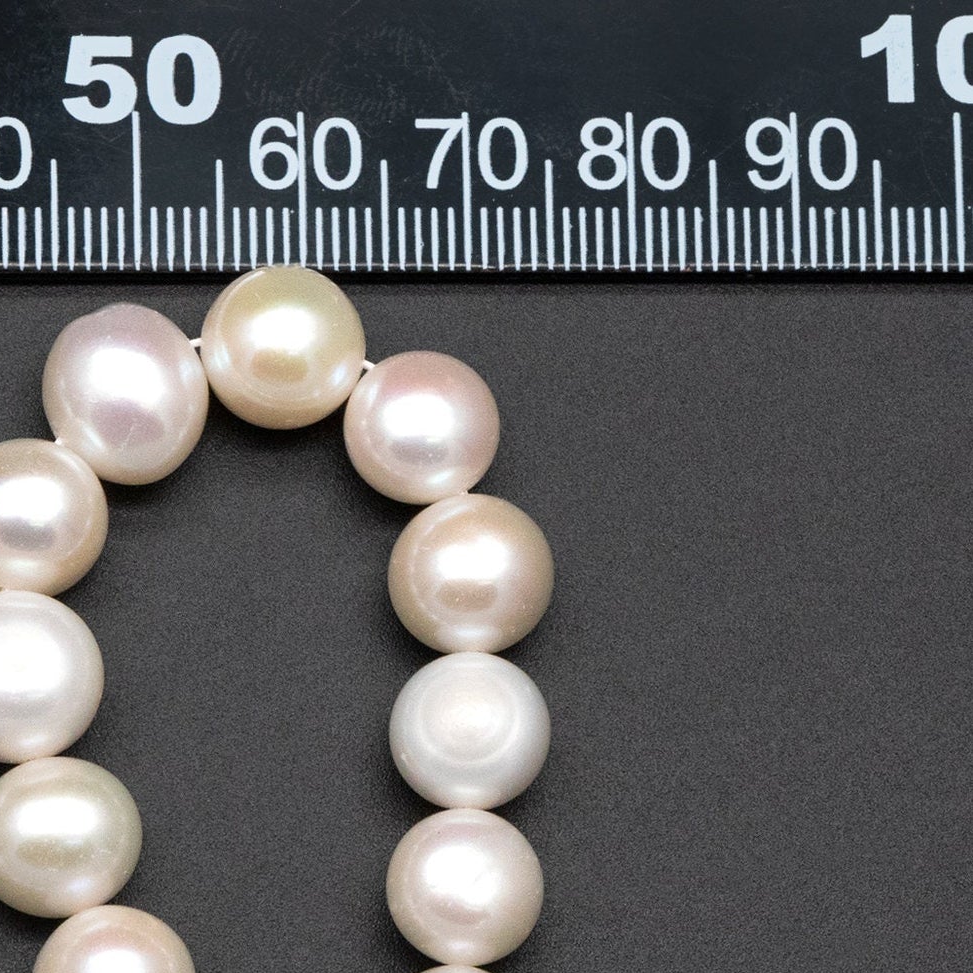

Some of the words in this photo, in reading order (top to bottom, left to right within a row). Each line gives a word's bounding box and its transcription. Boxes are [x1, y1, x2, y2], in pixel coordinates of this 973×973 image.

[61, 34, 222, 125] 50
[248, 116, 363, 191] 60
[414, 117, 527, 191] 70
[577, 117, 691, 191] 80
[744, 117, 859, 191] 90
